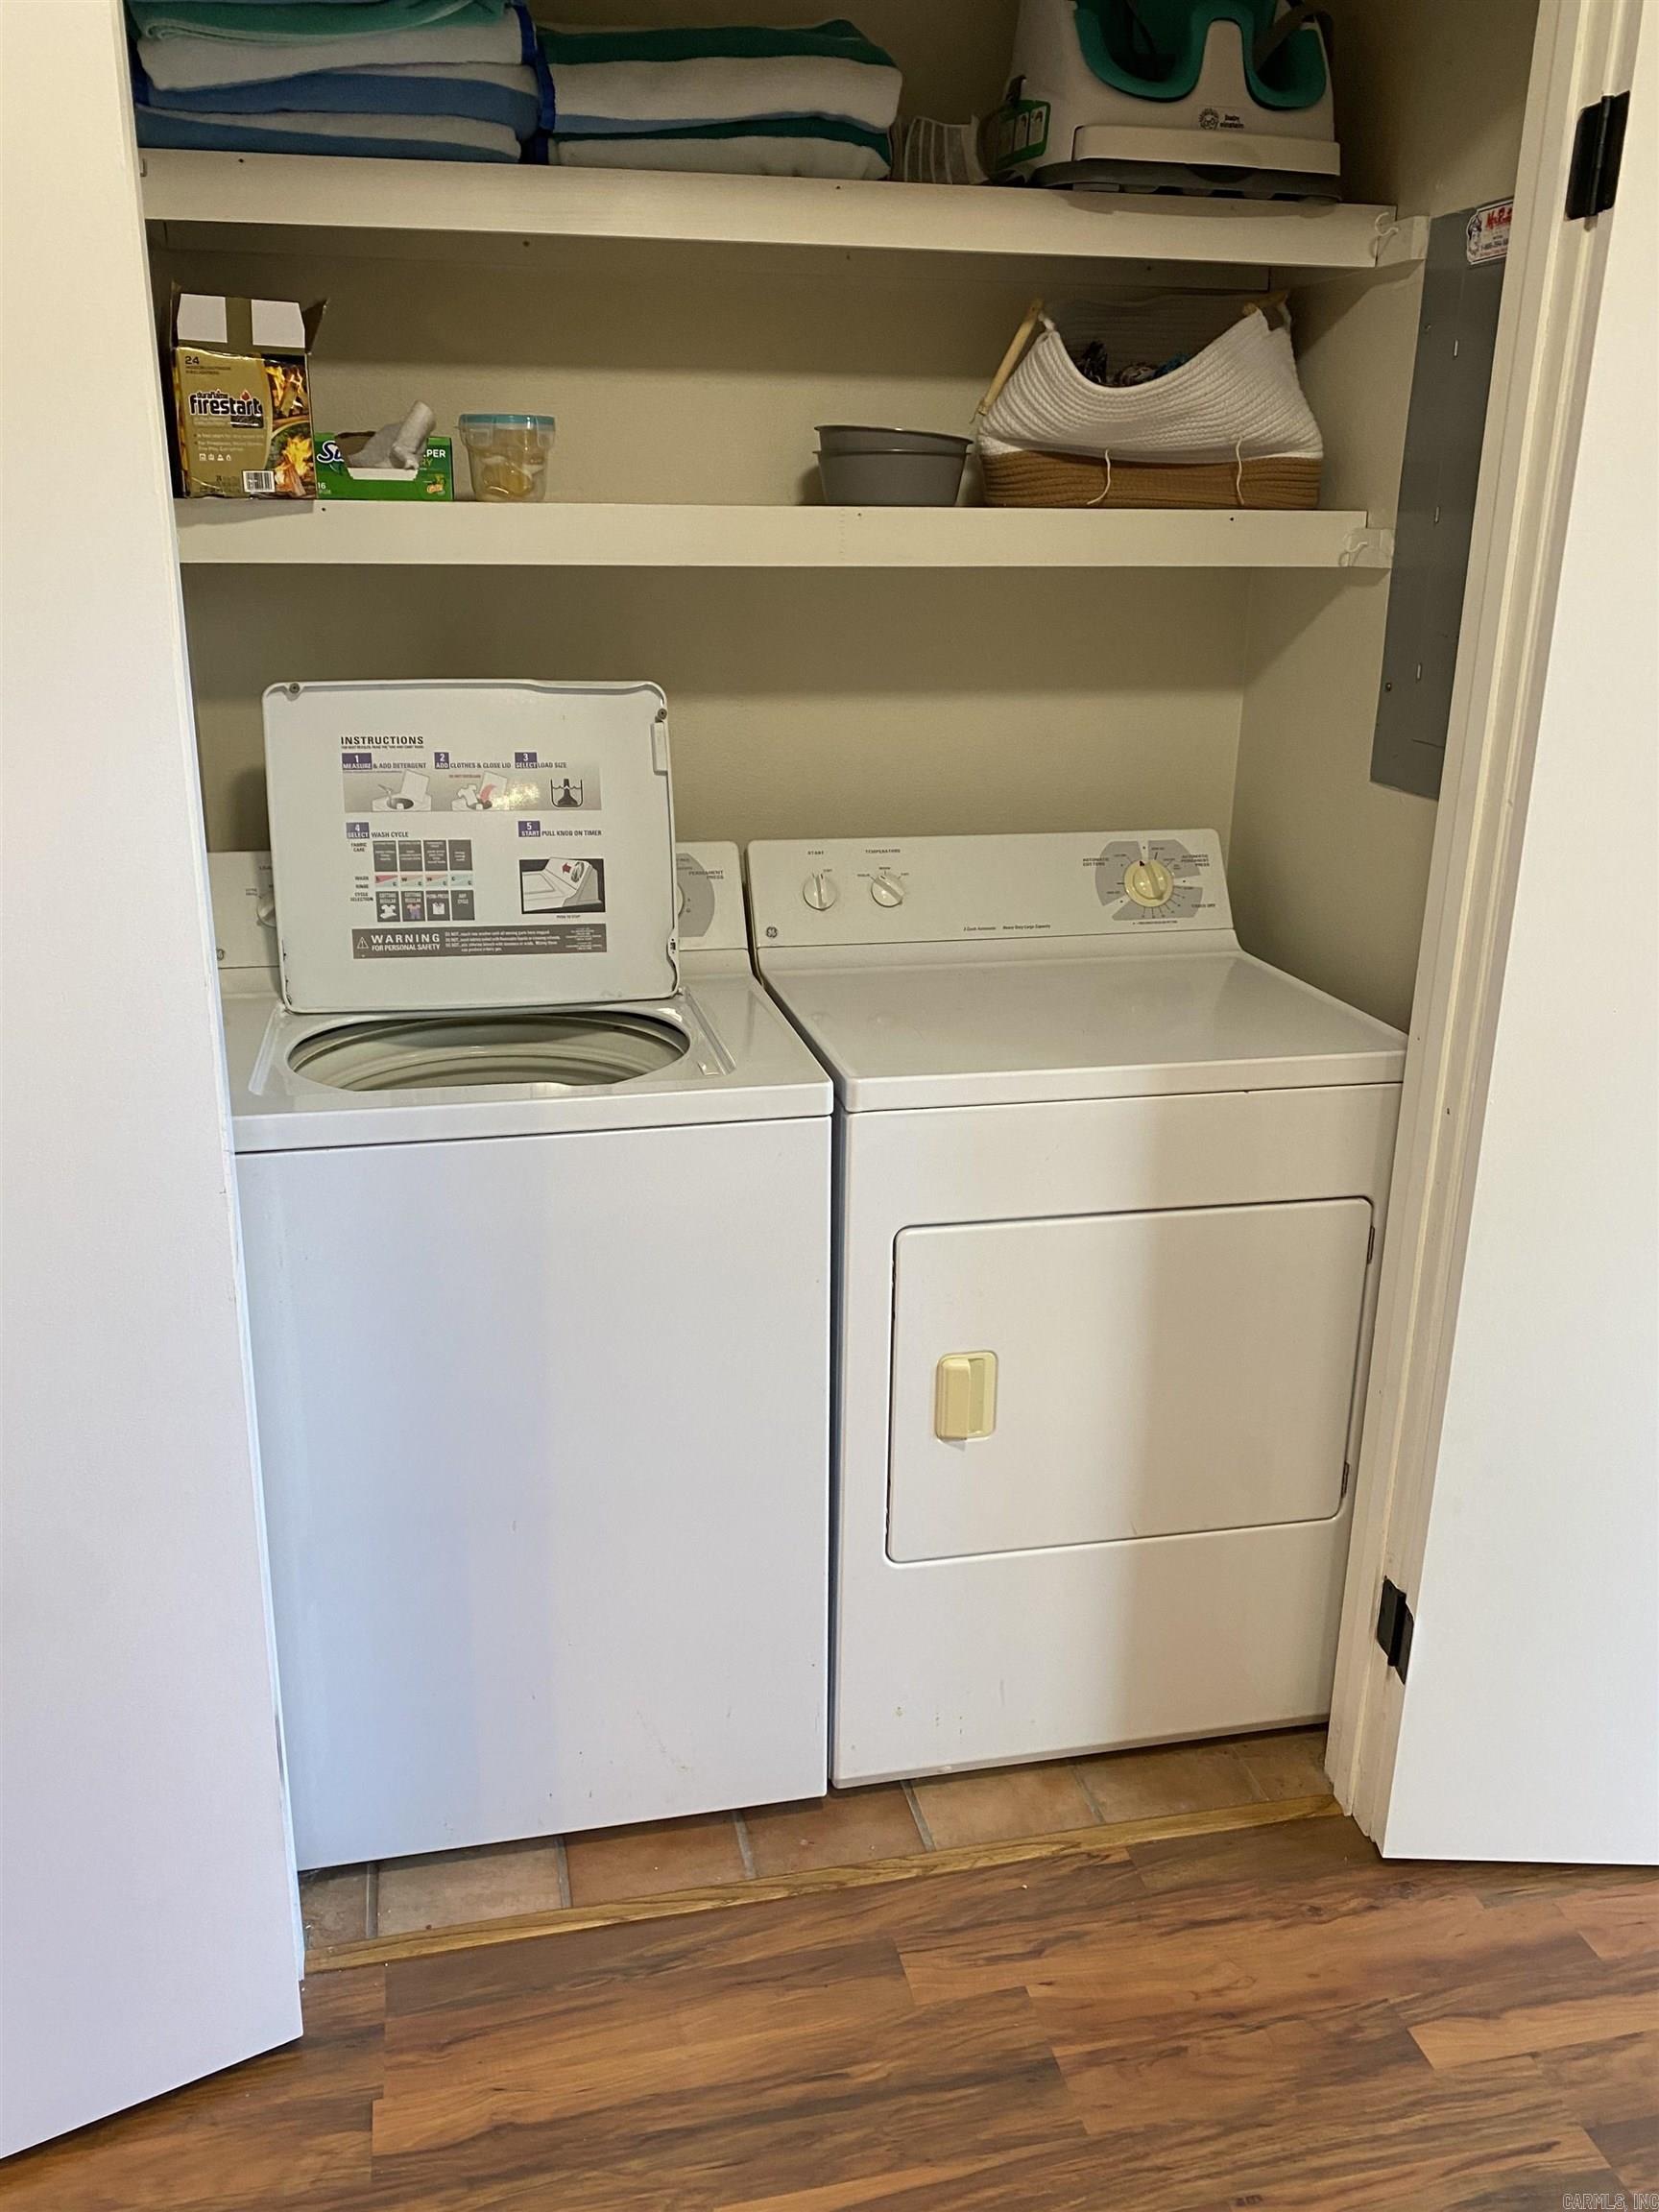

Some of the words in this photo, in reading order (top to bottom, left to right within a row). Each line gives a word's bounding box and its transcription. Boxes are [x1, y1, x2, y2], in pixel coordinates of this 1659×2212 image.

[184, 356, 200, 365] 24
[423, 449, 446, 458] PER
[341, 736, 424, 745] INSTRUCTIONS
[523, 753, 529, 761] 3
[354, 824, 360, 832] 4
[371, 933, 441, 944] WARNING
